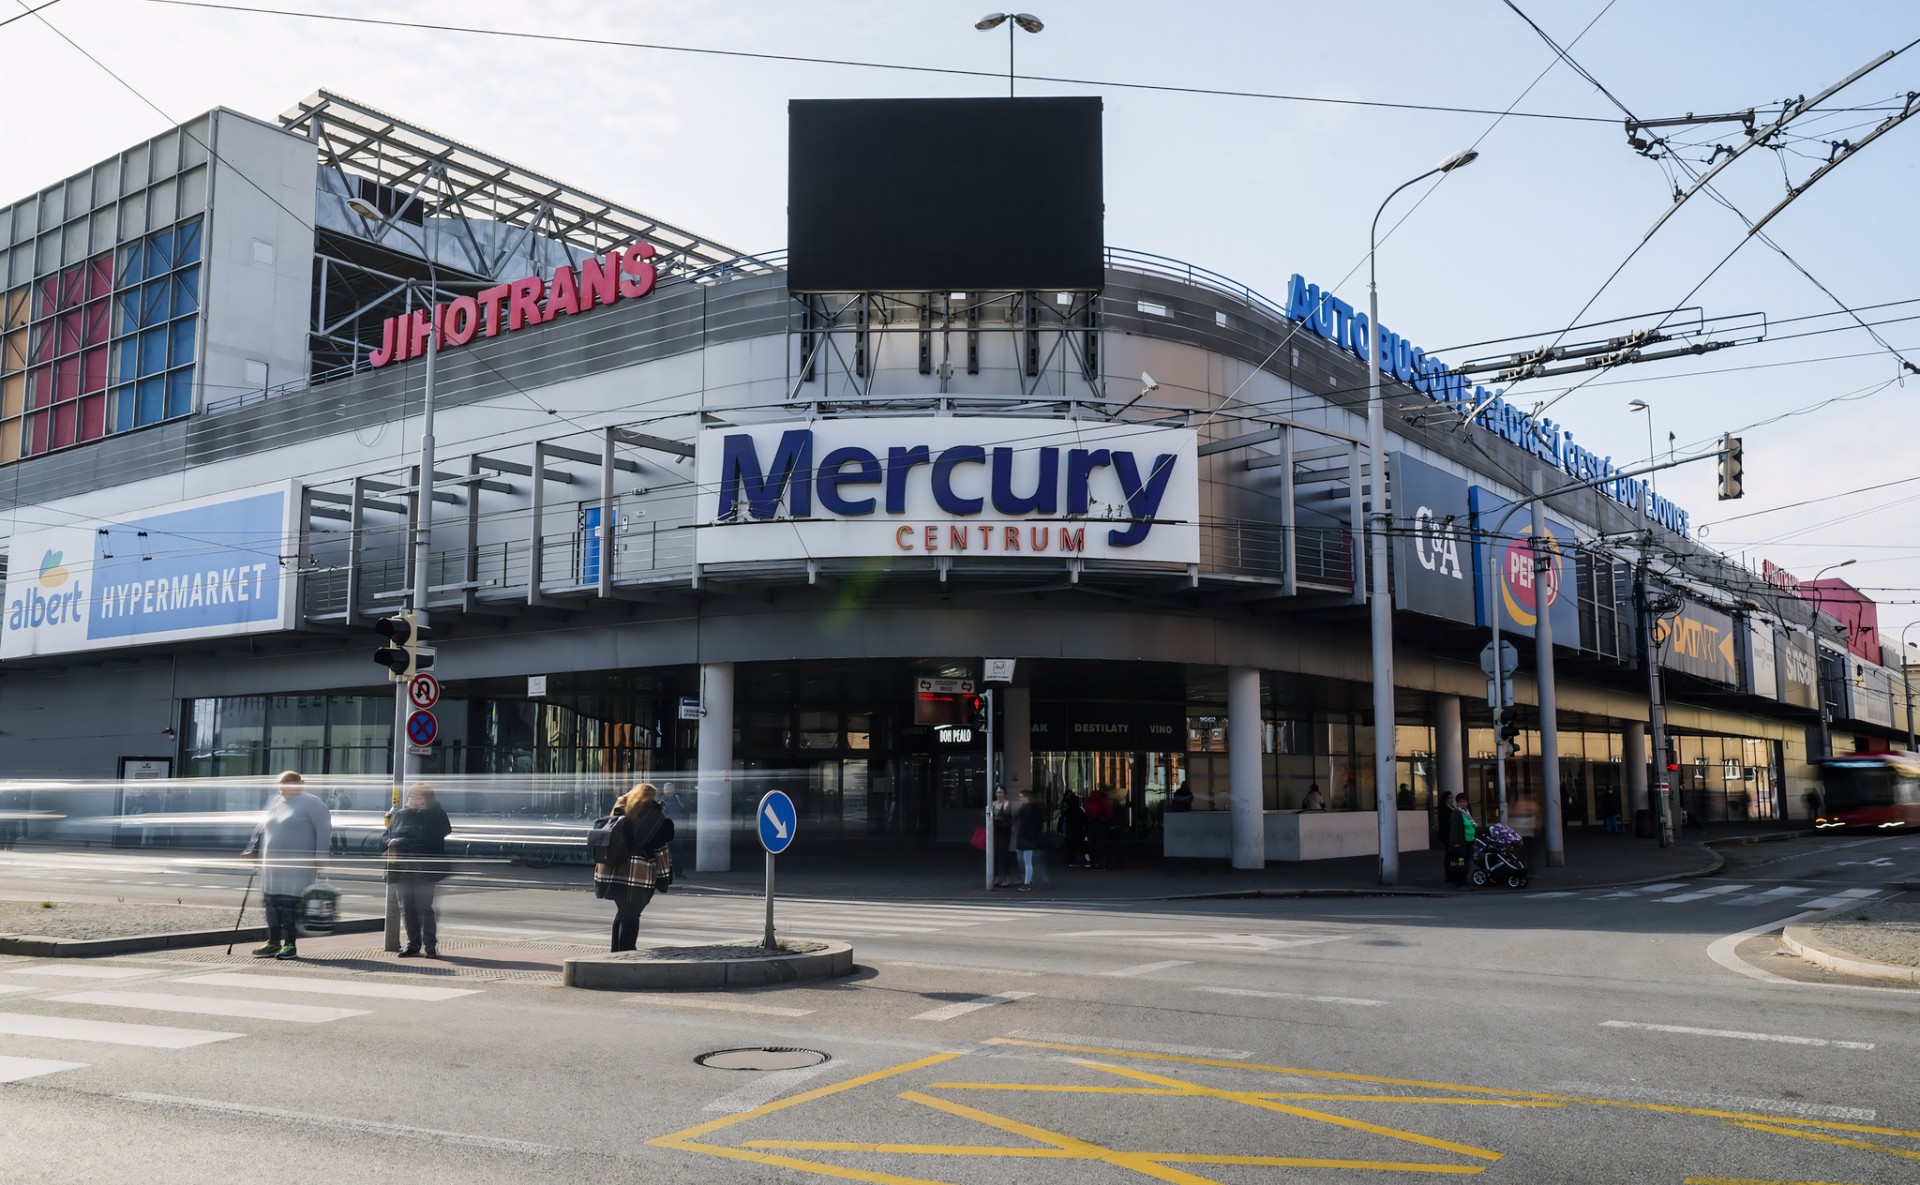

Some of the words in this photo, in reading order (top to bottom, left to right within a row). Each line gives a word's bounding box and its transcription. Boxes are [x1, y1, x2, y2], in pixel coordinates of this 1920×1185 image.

[368, 241, 658, 368] JIHOTRANS
[717, 428, 1178, 547] Mercury
[895, 524, 1086, 552] CENTRUM
[1414, 505, 1463, 580] C&A
[101, 562, 267, 619] HYPERMARKET
[1510, 551, 1557, 600] PEPO
[9, 579, 83, 631] albert
[1673, 613, 1719, 664] DATART
[1030, 721, 1048, 733] ÁK
[1074, 722, 1129, 734] DESTILÁTY
[1150, 723, 1173, 734] VÍNO
